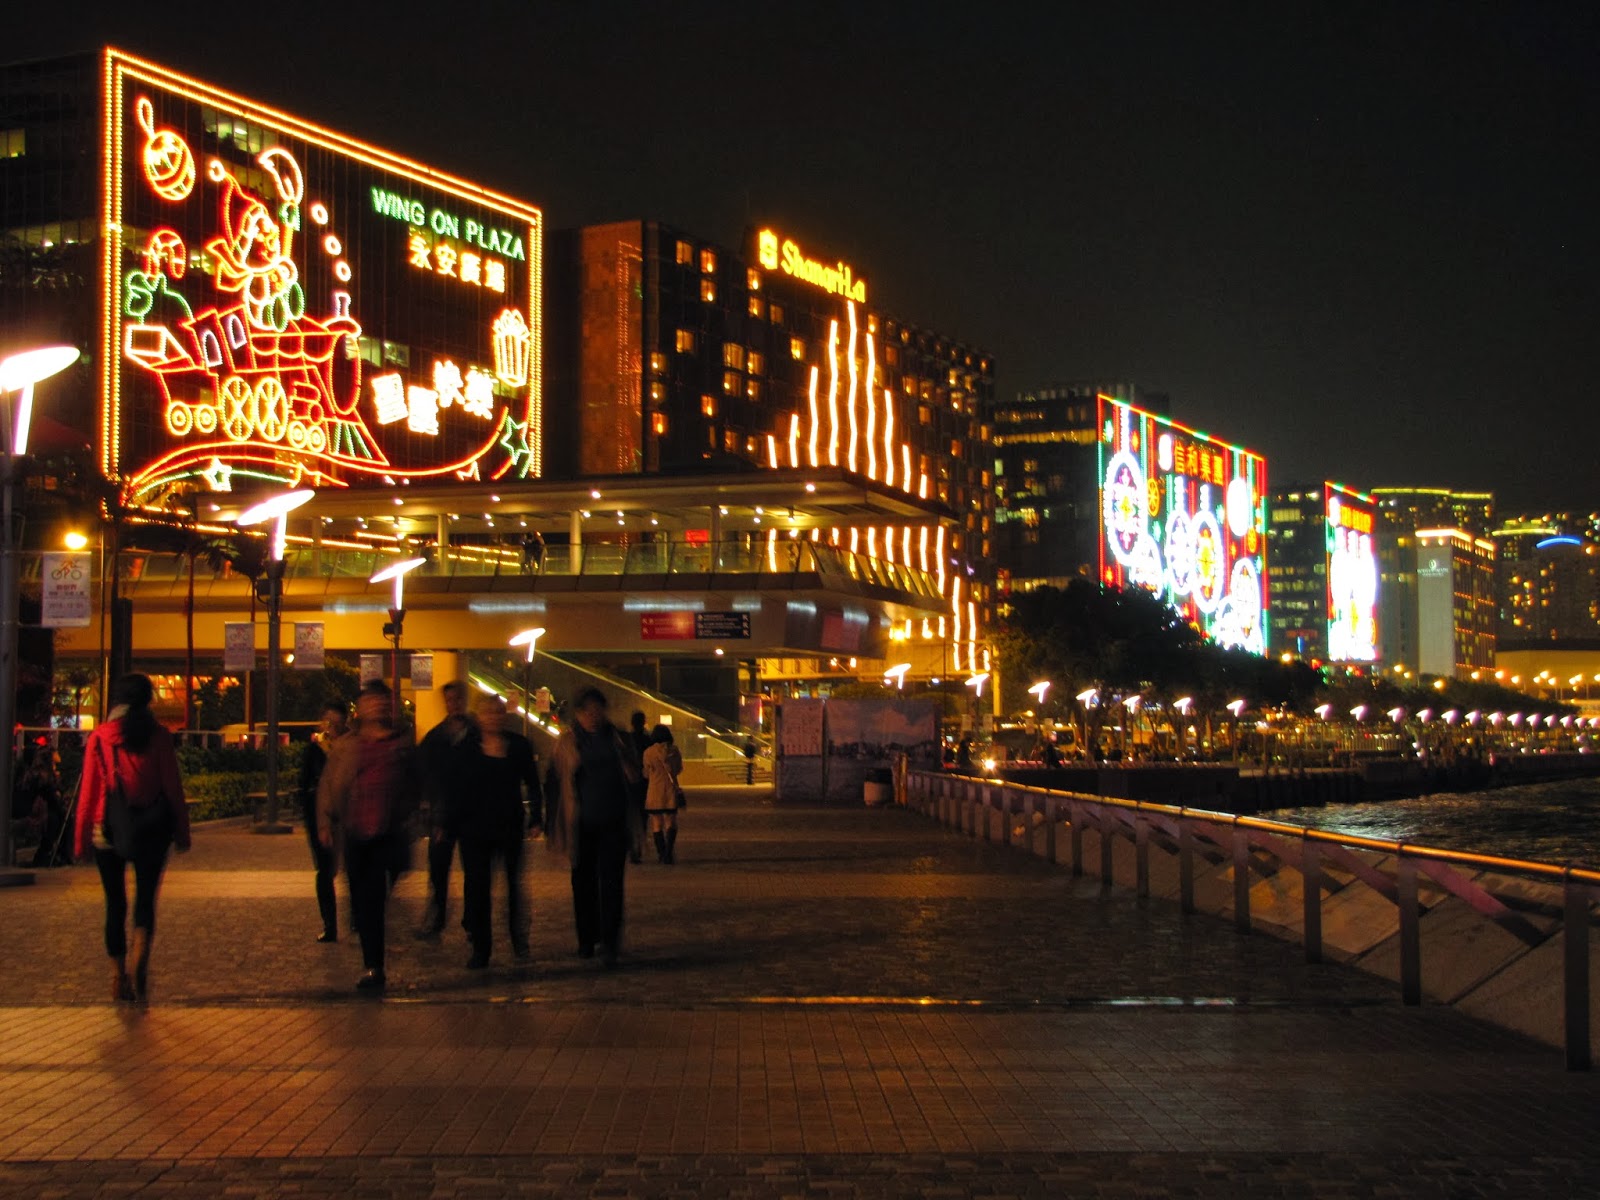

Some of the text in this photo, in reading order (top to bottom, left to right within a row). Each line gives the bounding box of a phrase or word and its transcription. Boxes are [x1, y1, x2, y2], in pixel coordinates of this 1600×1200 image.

[371, 187, 526, 261] WING ON PLAZA
